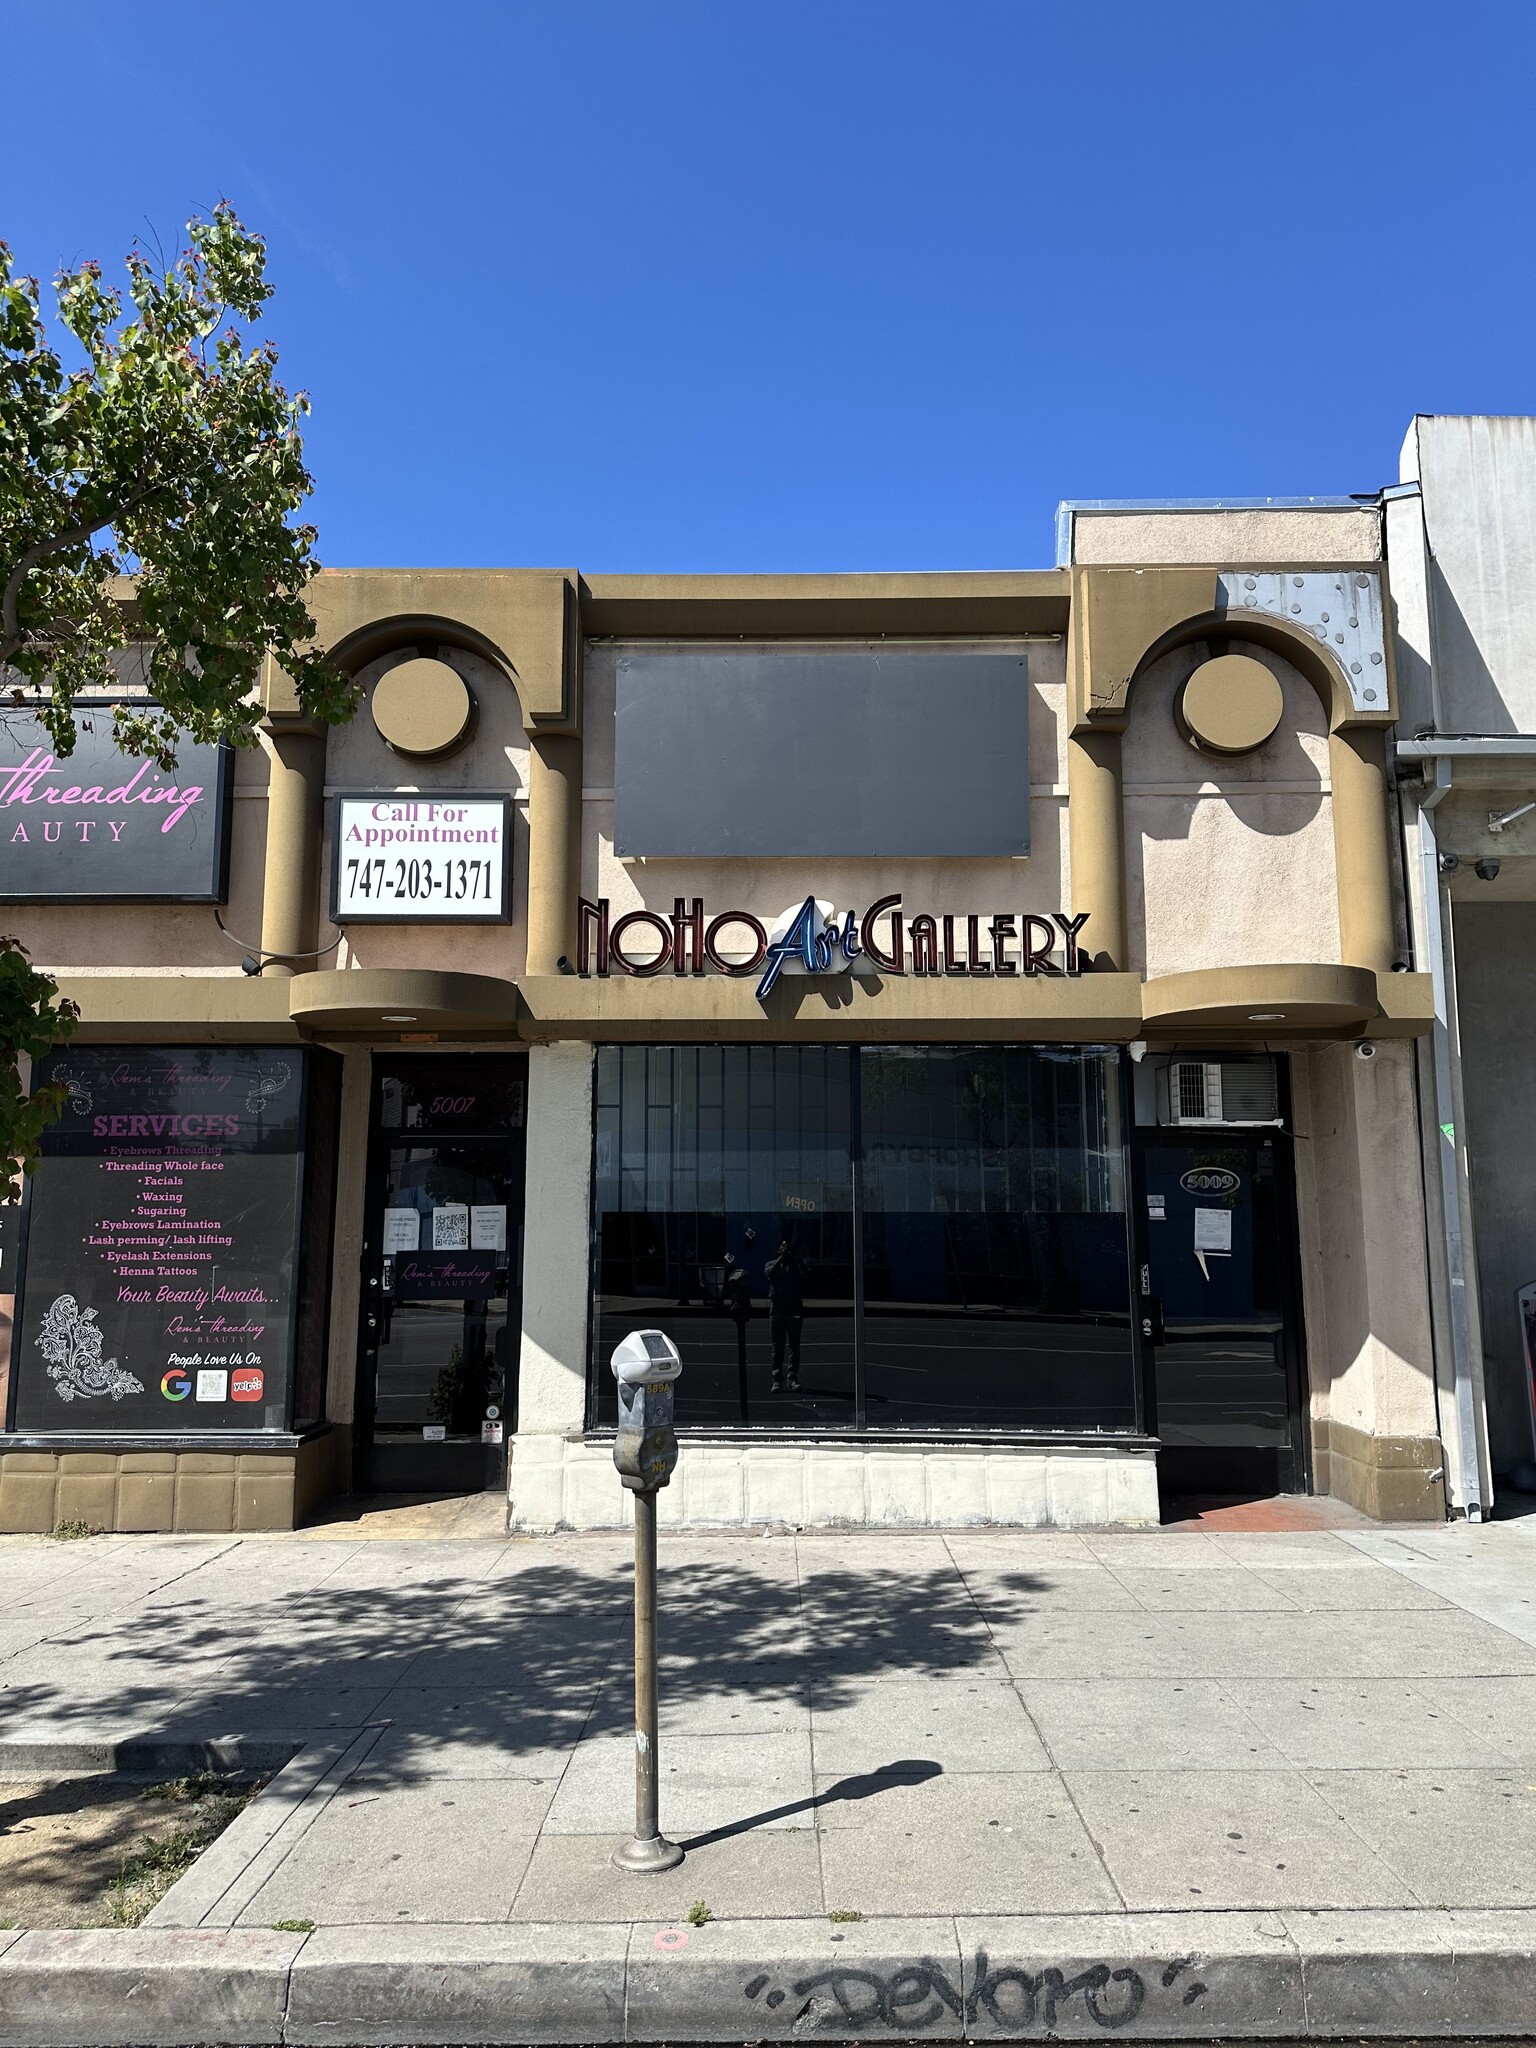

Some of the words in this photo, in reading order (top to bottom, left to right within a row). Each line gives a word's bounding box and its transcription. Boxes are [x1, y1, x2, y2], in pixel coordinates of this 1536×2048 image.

[0, 747, 204, 833] threading
[371, 802, 418, 822] Call
[427, 803, 468, 822] For
[345, 823, 499, 847] Appointment
[347, 858, 492, 899] 747-203-1371
[755, 895, 862, 999] Art
[148, 1087, 208, 1097] BEAUTY
[430, 1096, 476, 1114] 5007
[93, 1113, 240, 1137] SERVICES
[110, 1146, 162, 1158] Eyebrows
[164, 1145, 223, 1157] Threading
[105, 1161, 162, 1173] Threading
[163, 1161, 198, 1171] Whole
[200, 1161, 224, 1171] face
[144, 1176, 183, 1186] Facials
[1186, 1174, 1234, 1189] 5009
[142, 1192, 183, 1204] Waxing
[137, 1206, 187, 1218] Sugaring
[101, 1220, 154, 1232] Eyebrows
[156, 1220, 221, 1230] Lamination
[89, 1235, 115, 1245] Lash
[117, 1235, 171, 1247] perming/
[173, 1235, 196, 1245] lash
[198, 1235, 233, 1246] lifting
[106, 1251, 149, 1263] Eyelash
[152, 1251, 213, 1261] Extensions
[119, 1267, 155, 1276] Henna
[157, 1266, 198, 1276] Tattoos
[116, 1284, 152, 1303] Your
[155, 1285, 209, 1311] Beauty
[201, 1314, 266, 1341] threading
[167, 1352, 203, 1370] People
[204, 1352, 228, 1366] Love
[229, 1352, 244, 1365] Us
[245, 1352, 262, 1365] On
[233, 1380, 253, 1392] yelp
[652, 1461, 666, 1473] NH
